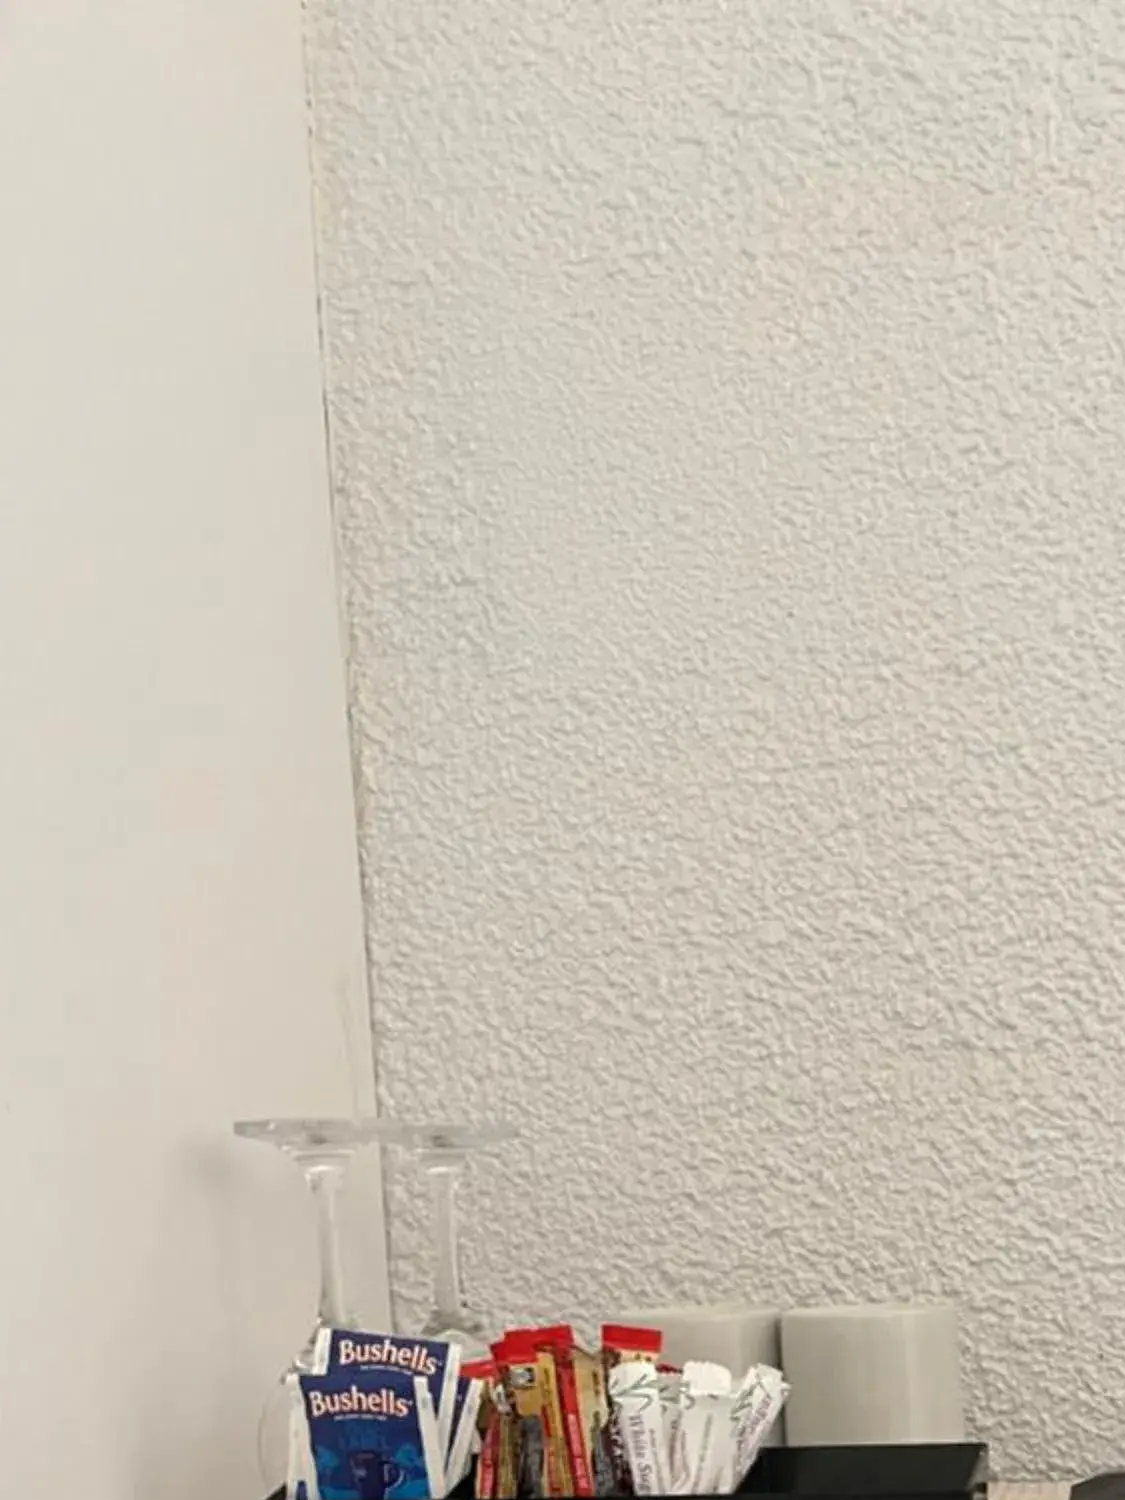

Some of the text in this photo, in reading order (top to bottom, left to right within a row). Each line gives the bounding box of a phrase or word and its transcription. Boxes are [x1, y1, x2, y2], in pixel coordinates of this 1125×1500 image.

[338, 1338, 437, 1375] Bushells
[308, 1384, 408, 1418] Bushells
[628, 1413, 654, 1493] White Sug
